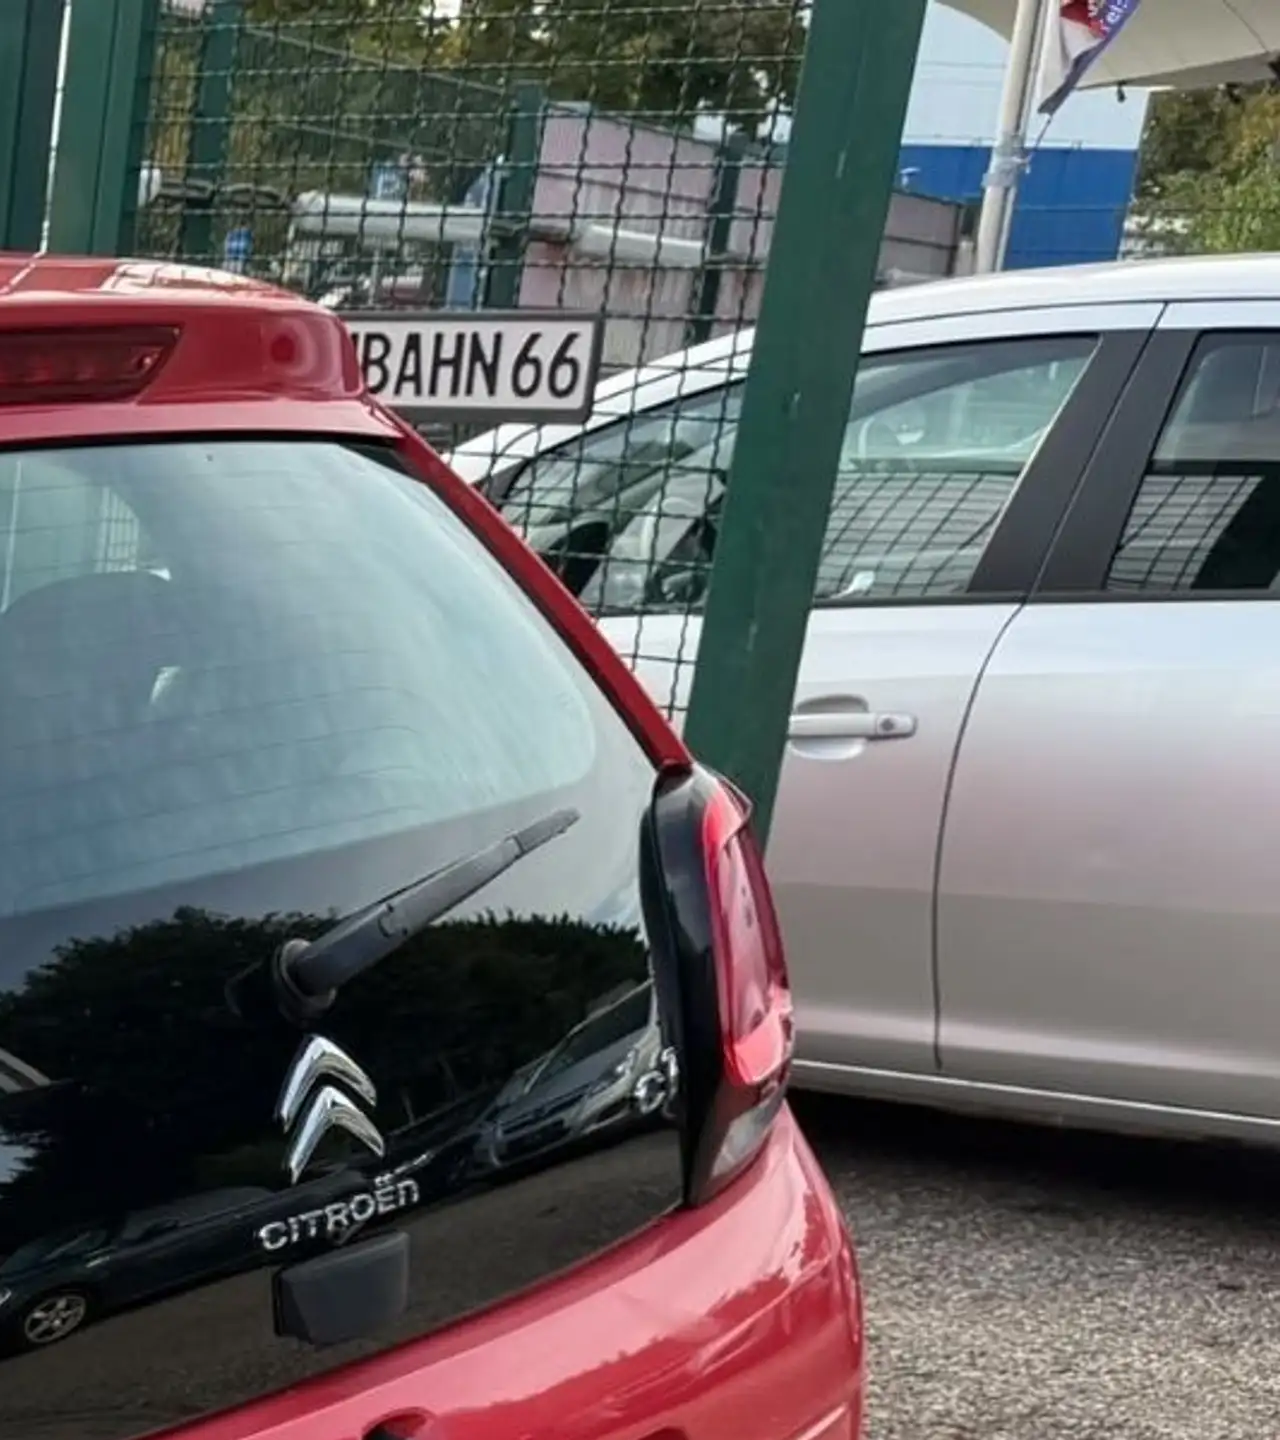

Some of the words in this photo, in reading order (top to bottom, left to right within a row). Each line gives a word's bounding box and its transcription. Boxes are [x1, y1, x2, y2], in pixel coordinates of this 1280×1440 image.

[351, 331, 503, 397] BAHN
[510, 332, 581, 398] 66
[258, 1173, 419, 1250] CITROËN
